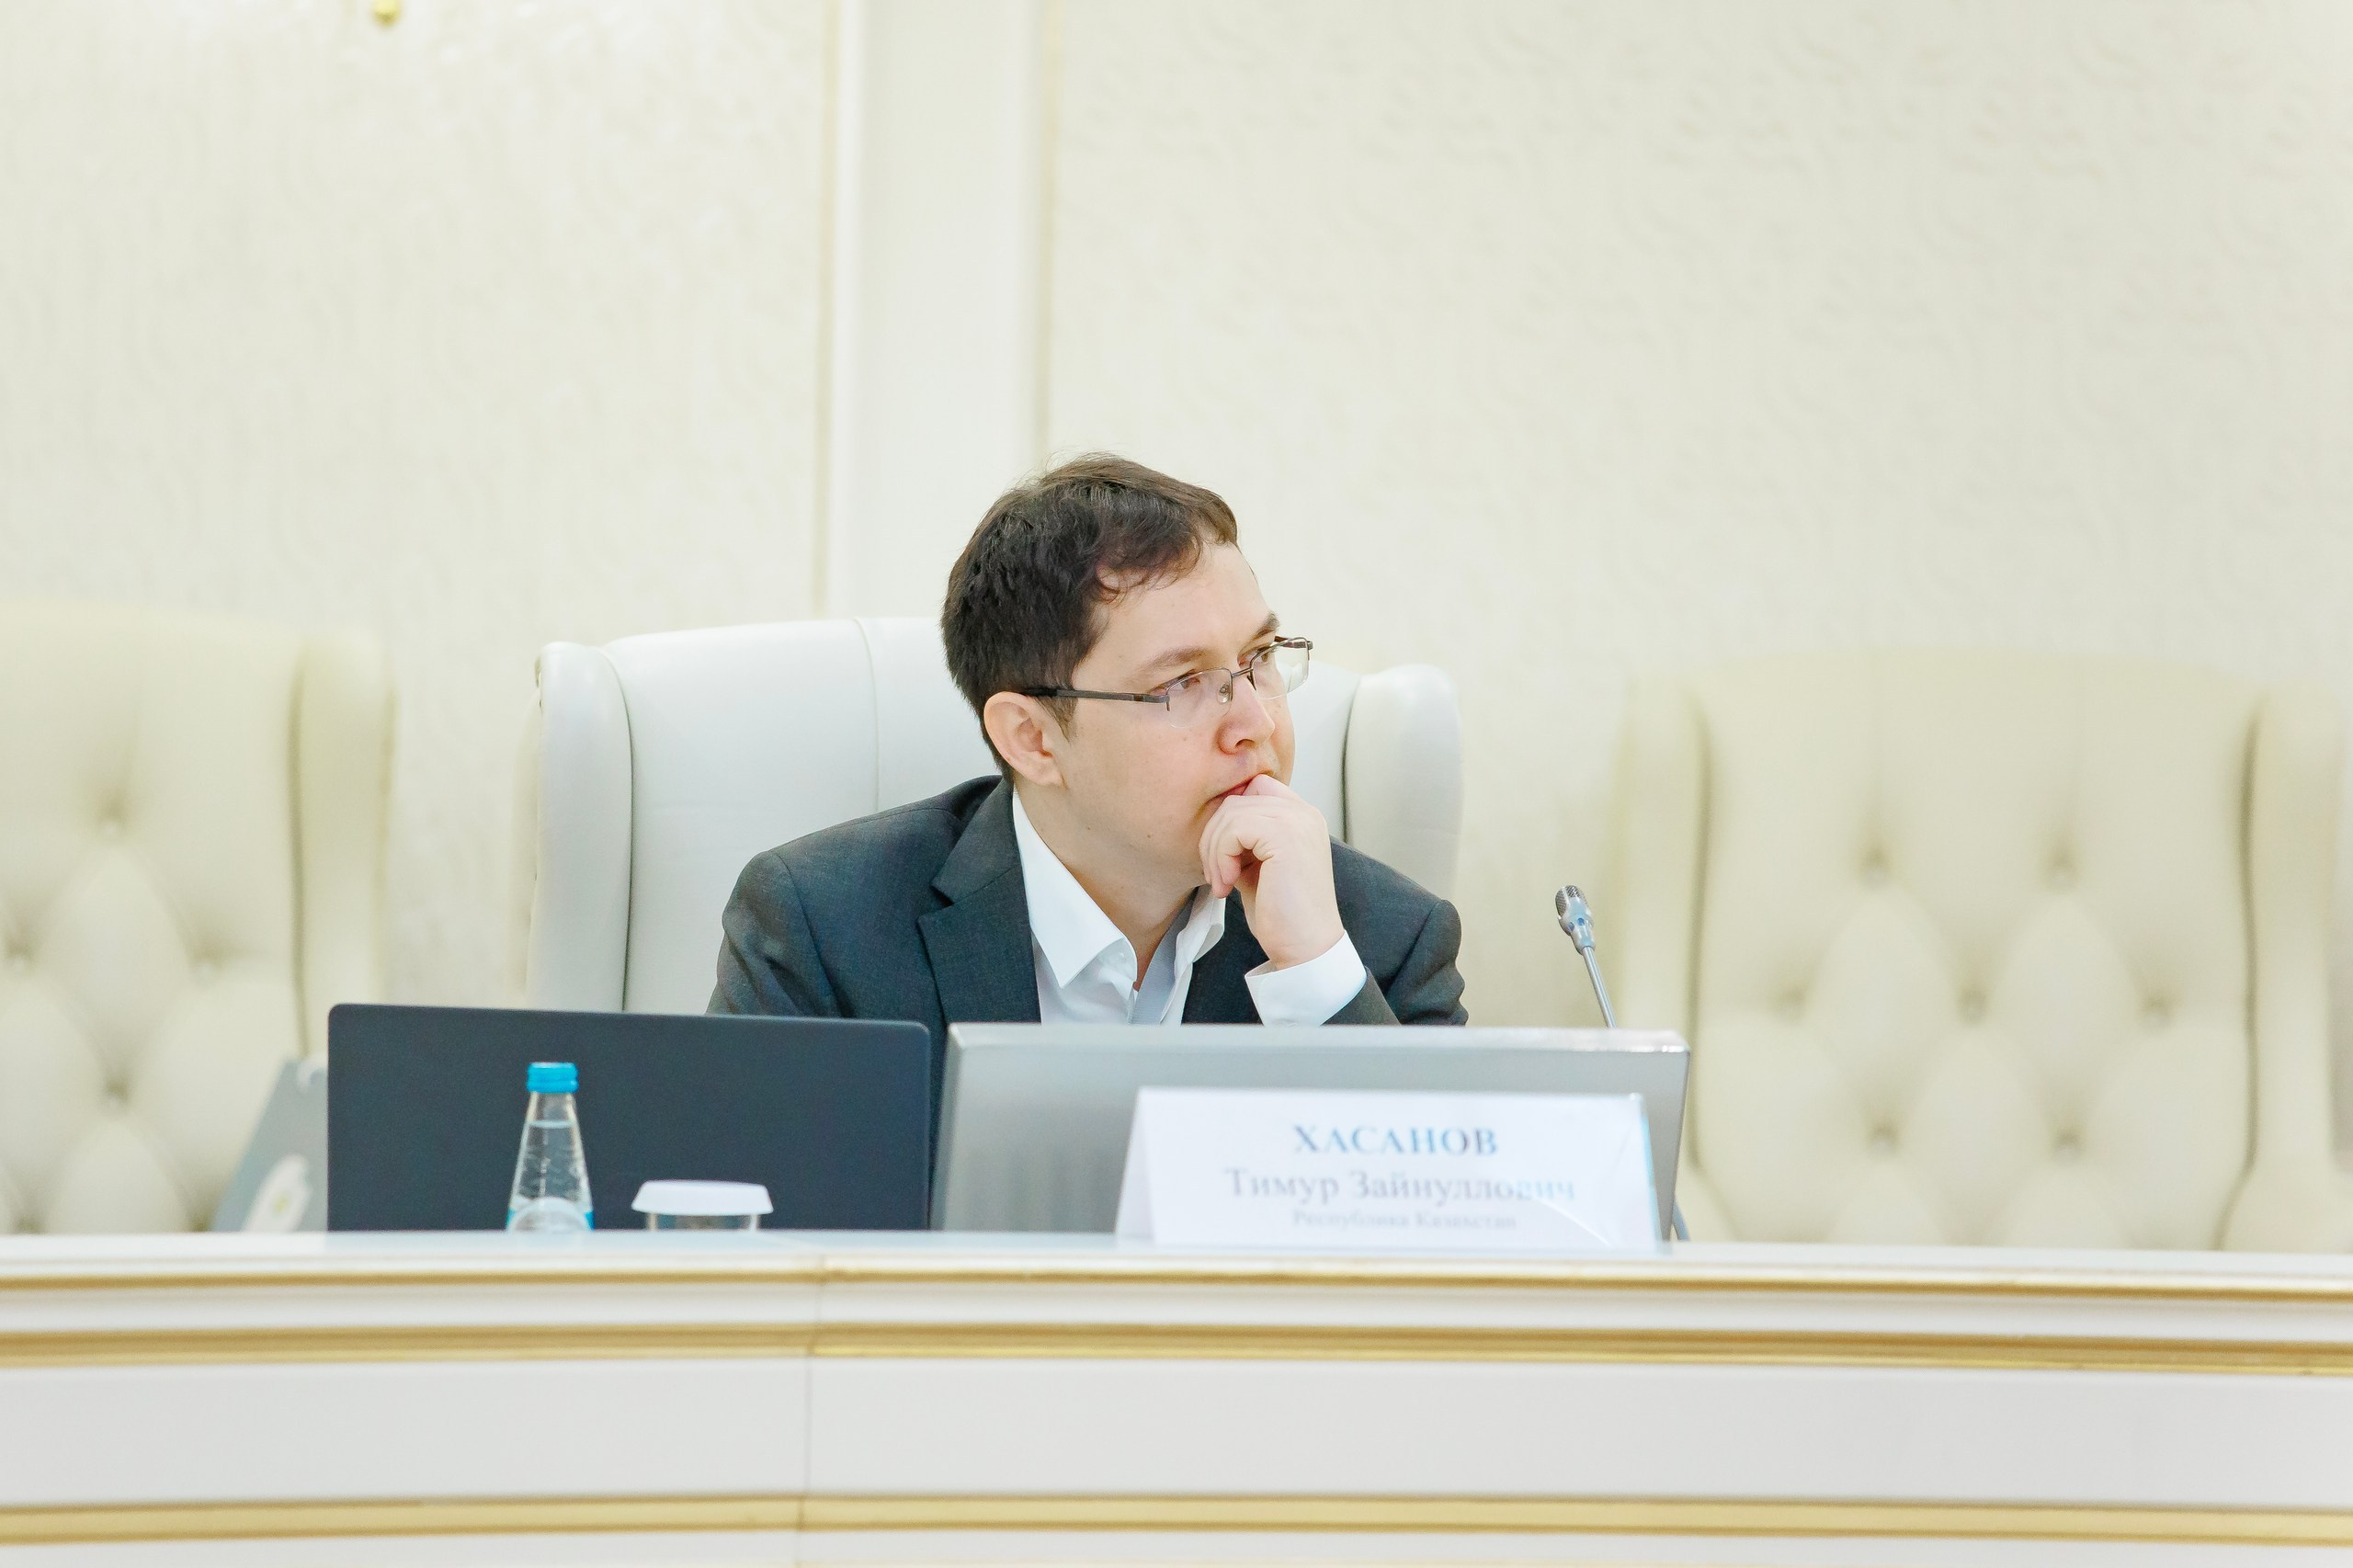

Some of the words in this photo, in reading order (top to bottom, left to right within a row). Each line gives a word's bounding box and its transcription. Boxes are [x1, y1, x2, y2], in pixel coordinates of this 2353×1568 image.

[1292, 1125, 1499, 1155] ХАСАНОВ
[1224, 1167, 1339, 1204] Тимур
[1349, 1168, 1575, 1207] Зайнуллович
